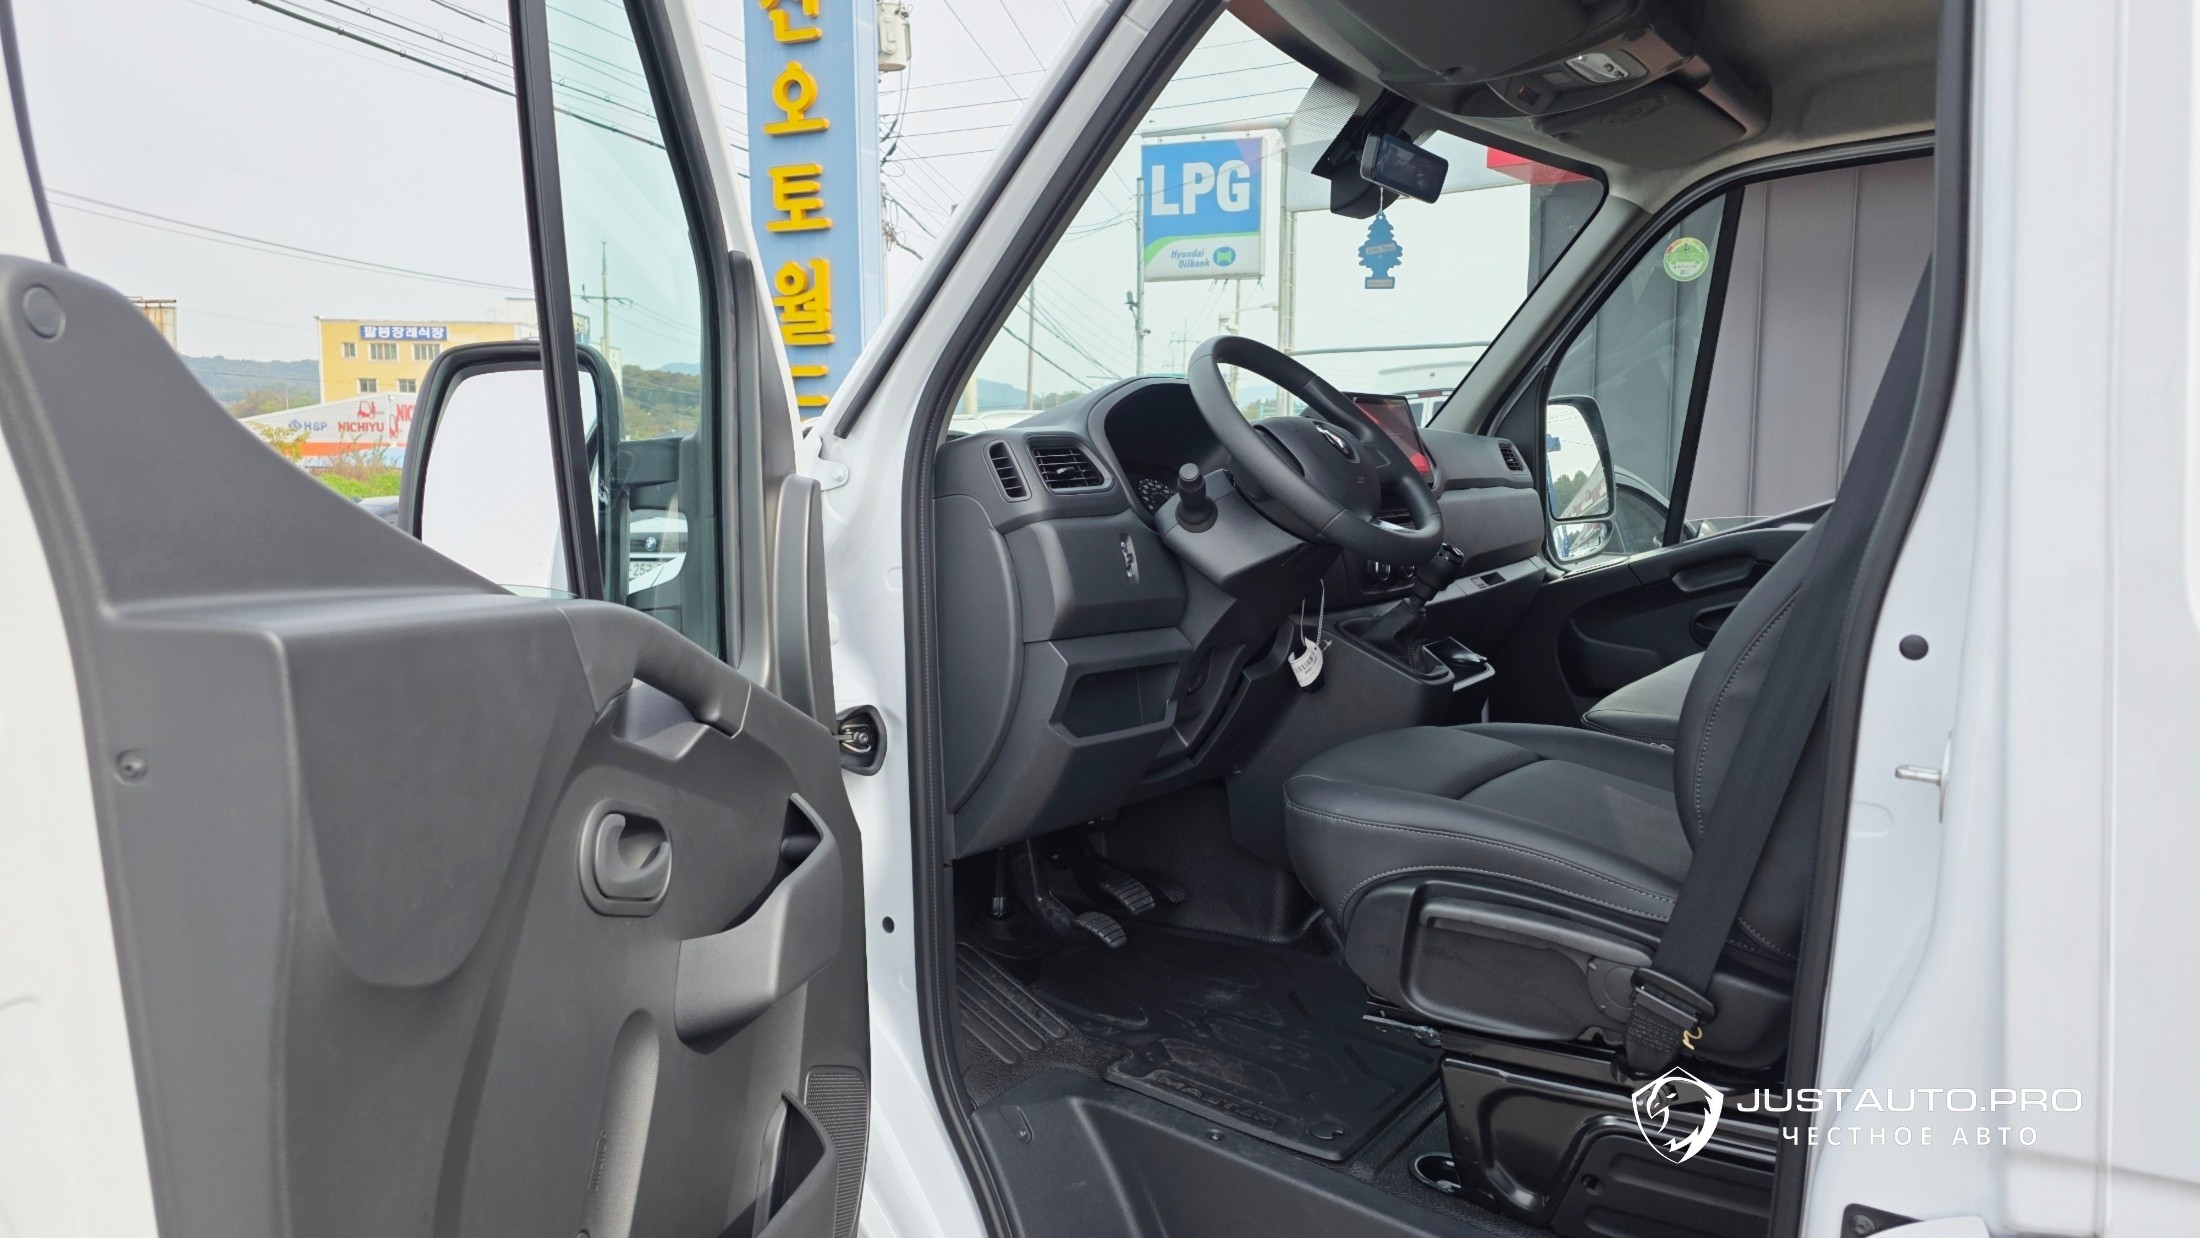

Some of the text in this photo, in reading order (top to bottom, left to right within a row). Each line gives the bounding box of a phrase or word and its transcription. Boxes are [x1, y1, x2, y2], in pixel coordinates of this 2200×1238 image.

[1151, 160, 1250, 216] LPG
[1171, 248, 1205, 260] Hyundai
[1178, 259, 1210, 268] Oilbank
[303, 421, 327, 431] HSP
[338, 421, 384, 432] NICHIYU
